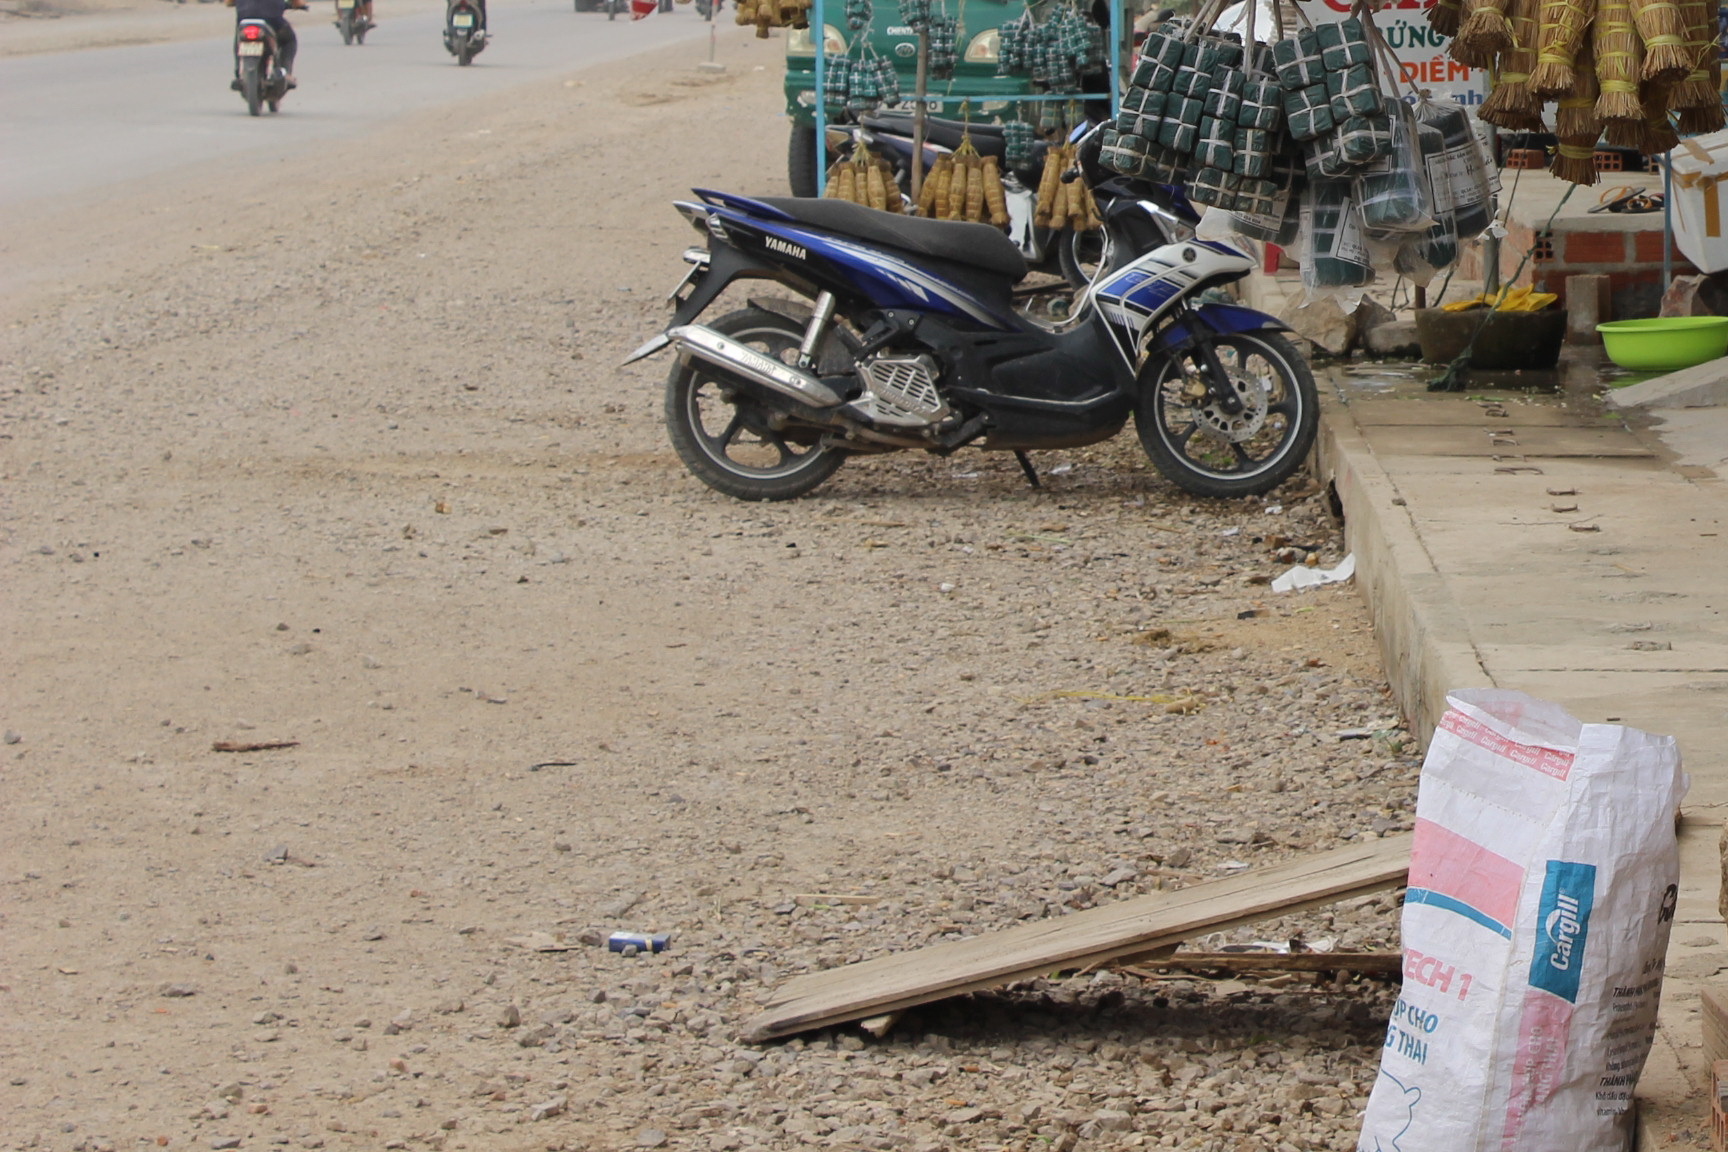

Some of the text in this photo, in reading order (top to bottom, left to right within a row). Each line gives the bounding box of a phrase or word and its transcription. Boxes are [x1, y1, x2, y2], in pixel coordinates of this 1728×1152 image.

[1377, 19, 1446, 48] ỨNG
[765, 236, 807, 260] YAMAHA
[1550, 893, 1581, 971] Cargill
[1458, 973, 1472, 1001] 1
[1408, 1005, 1438, 1033] CHO
[1397, 1031, 1428, 1066] THAI
